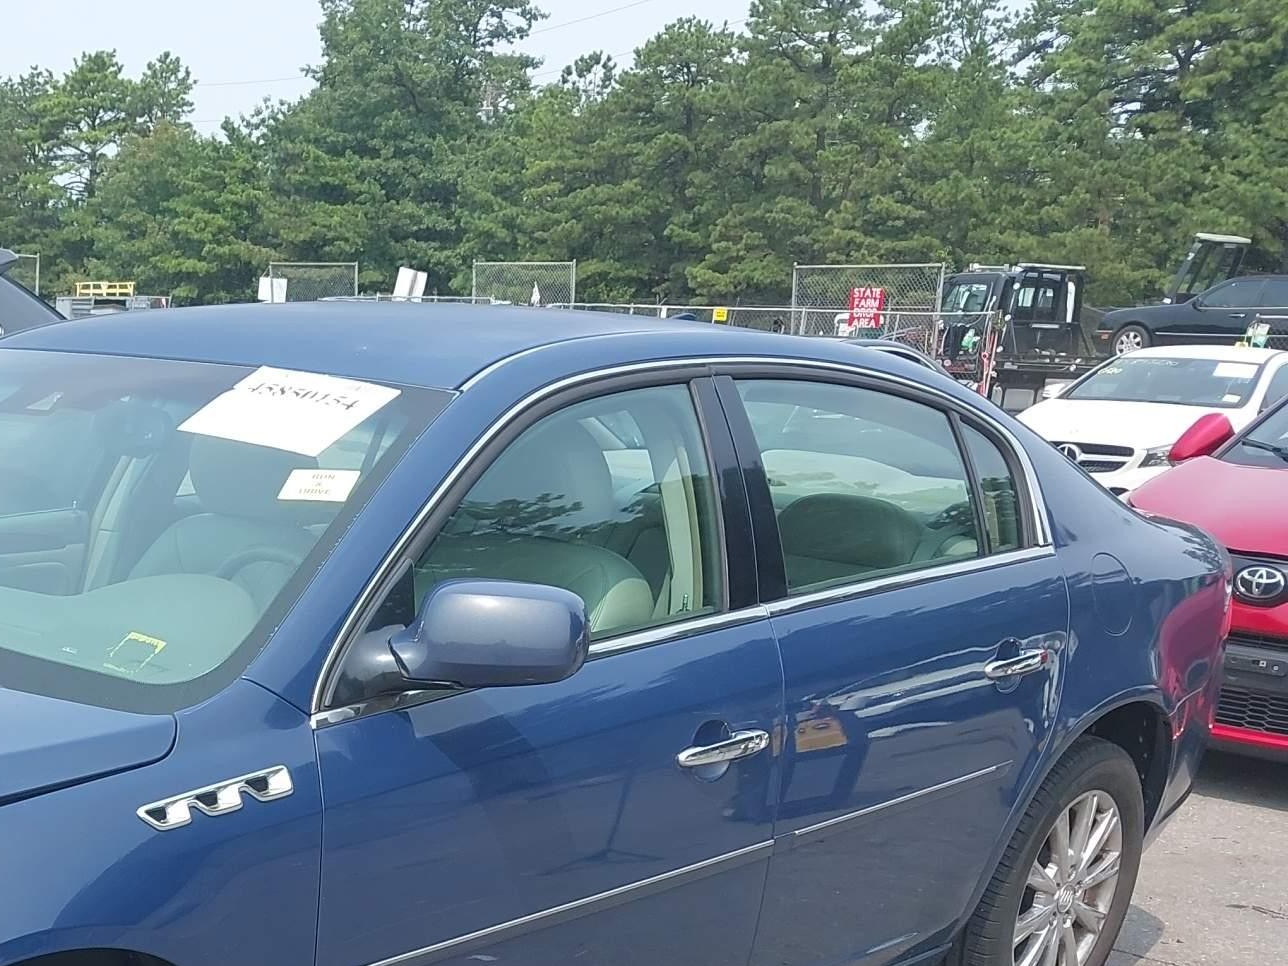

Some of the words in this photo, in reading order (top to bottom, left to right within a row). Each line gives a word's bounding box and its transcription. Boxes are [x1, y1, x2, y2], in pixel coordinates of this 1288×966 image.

[853, 287, 881, 298] STATE
[854, 298, 879, 308] FARM
[853, 307, 877, 317] DROP
[852, 318, 876, 328] AREA
